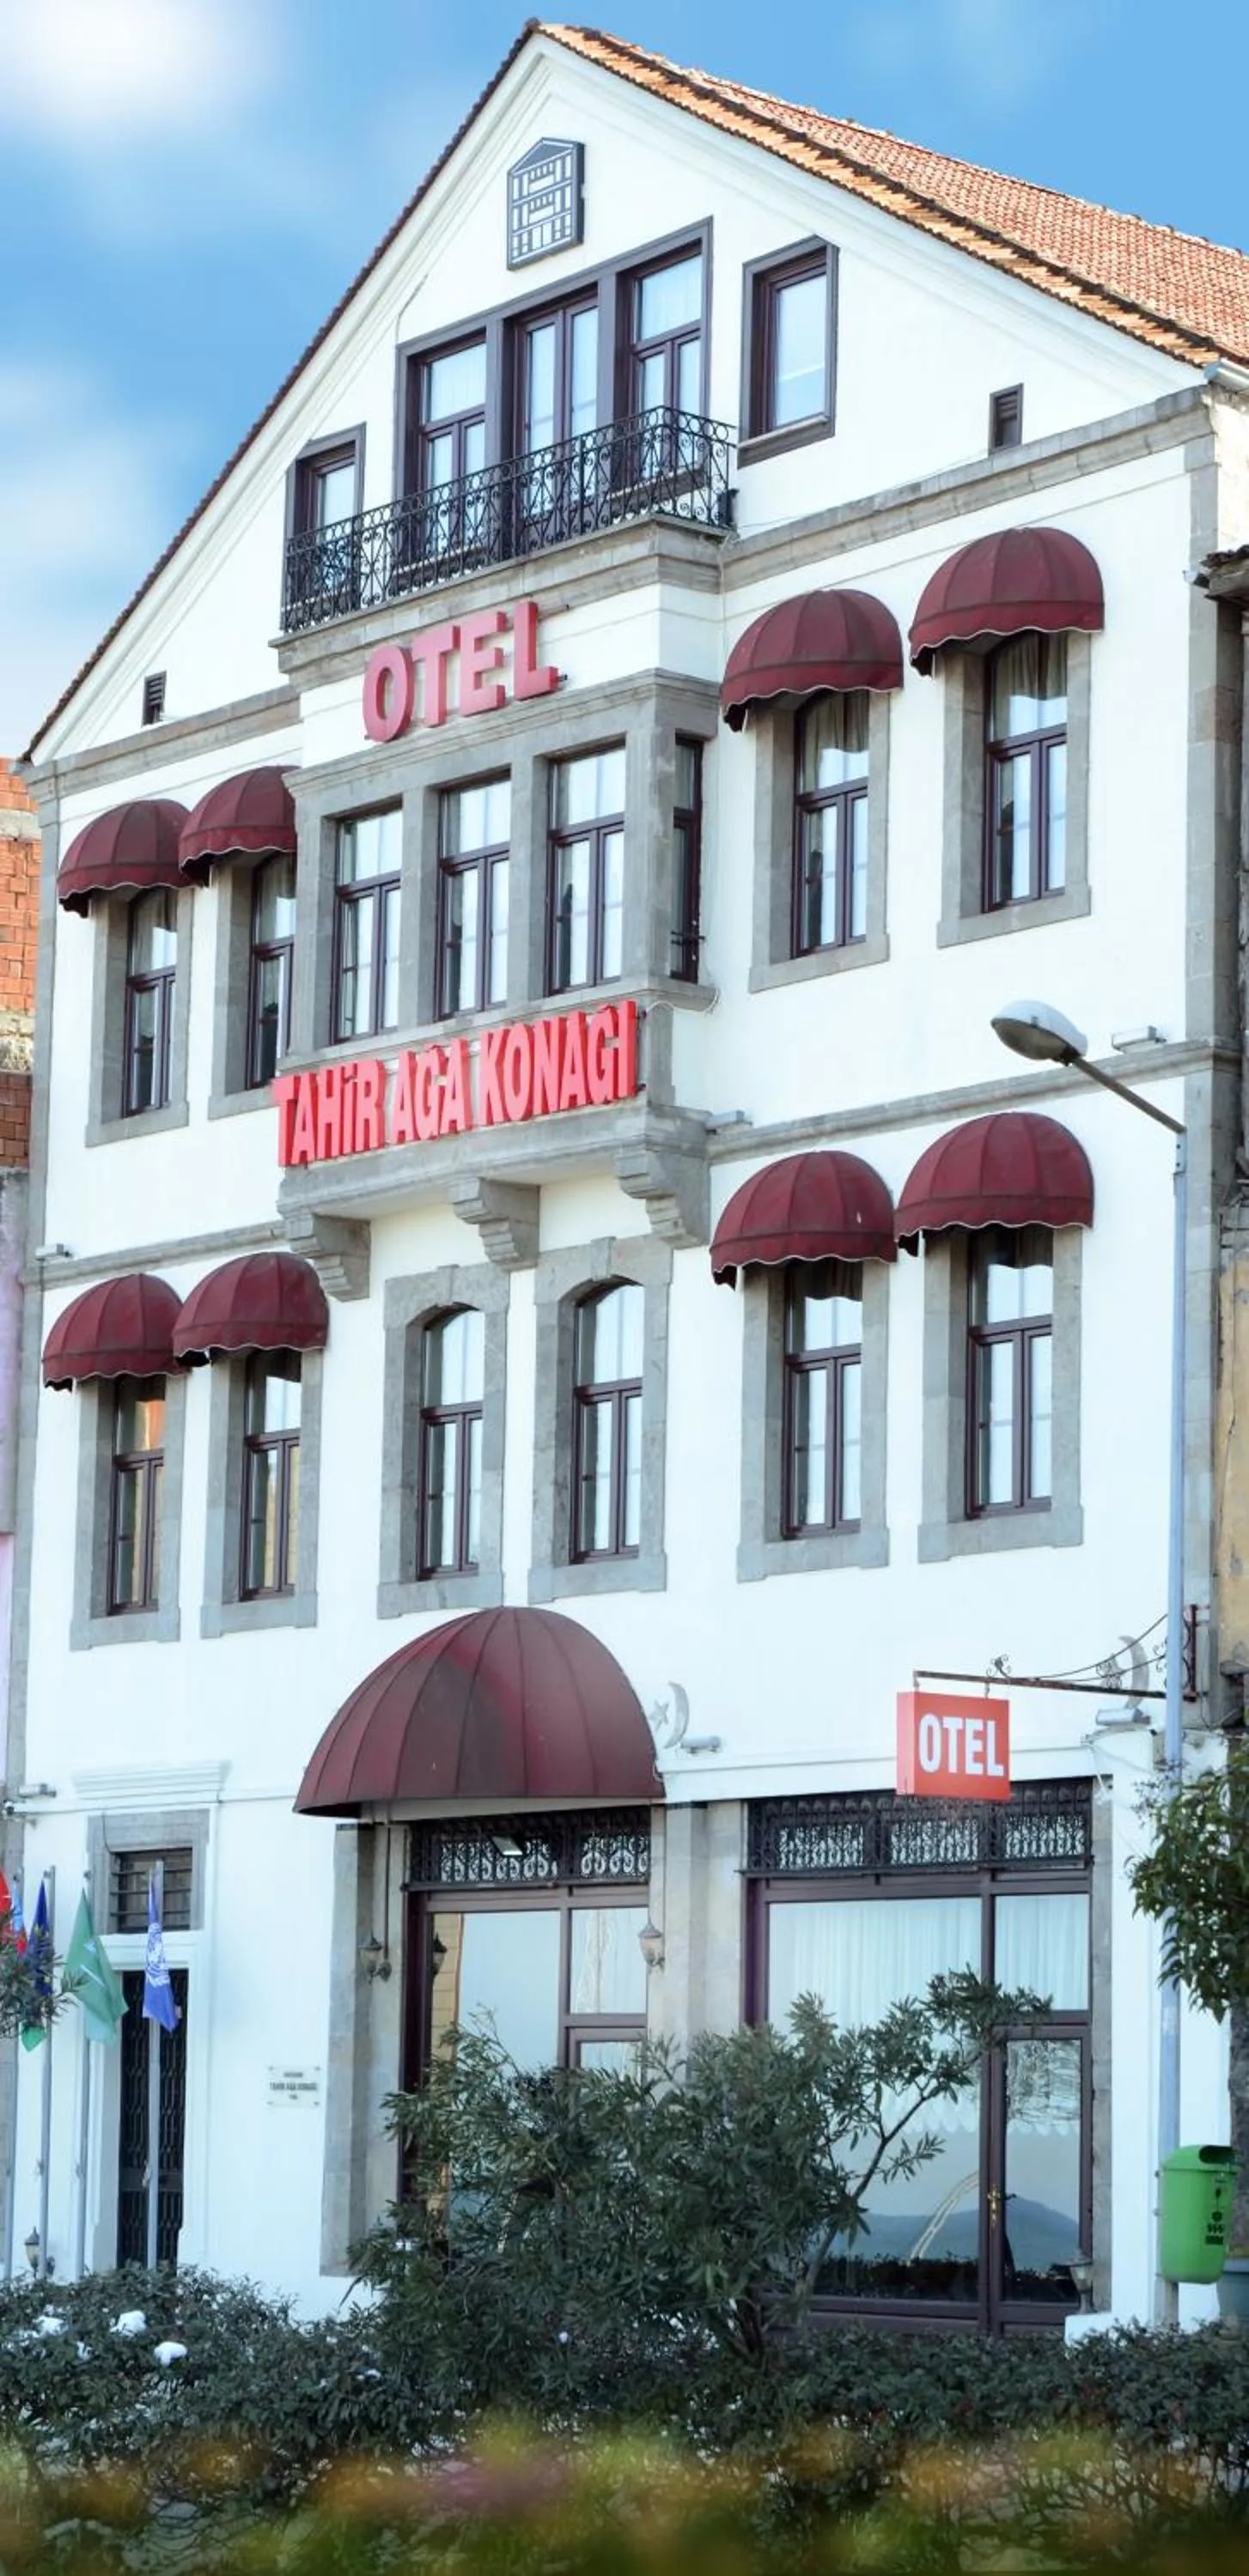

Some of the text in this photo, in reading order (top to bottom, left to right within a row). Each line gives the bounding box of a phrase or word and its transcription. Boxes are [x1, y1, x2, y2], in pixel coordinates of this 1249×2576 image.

[363, 600, 558, 743] OTEL
[271, 1059, 386, 1167] TAHİR
[918, 1712, 1004, 1777] OTEL
